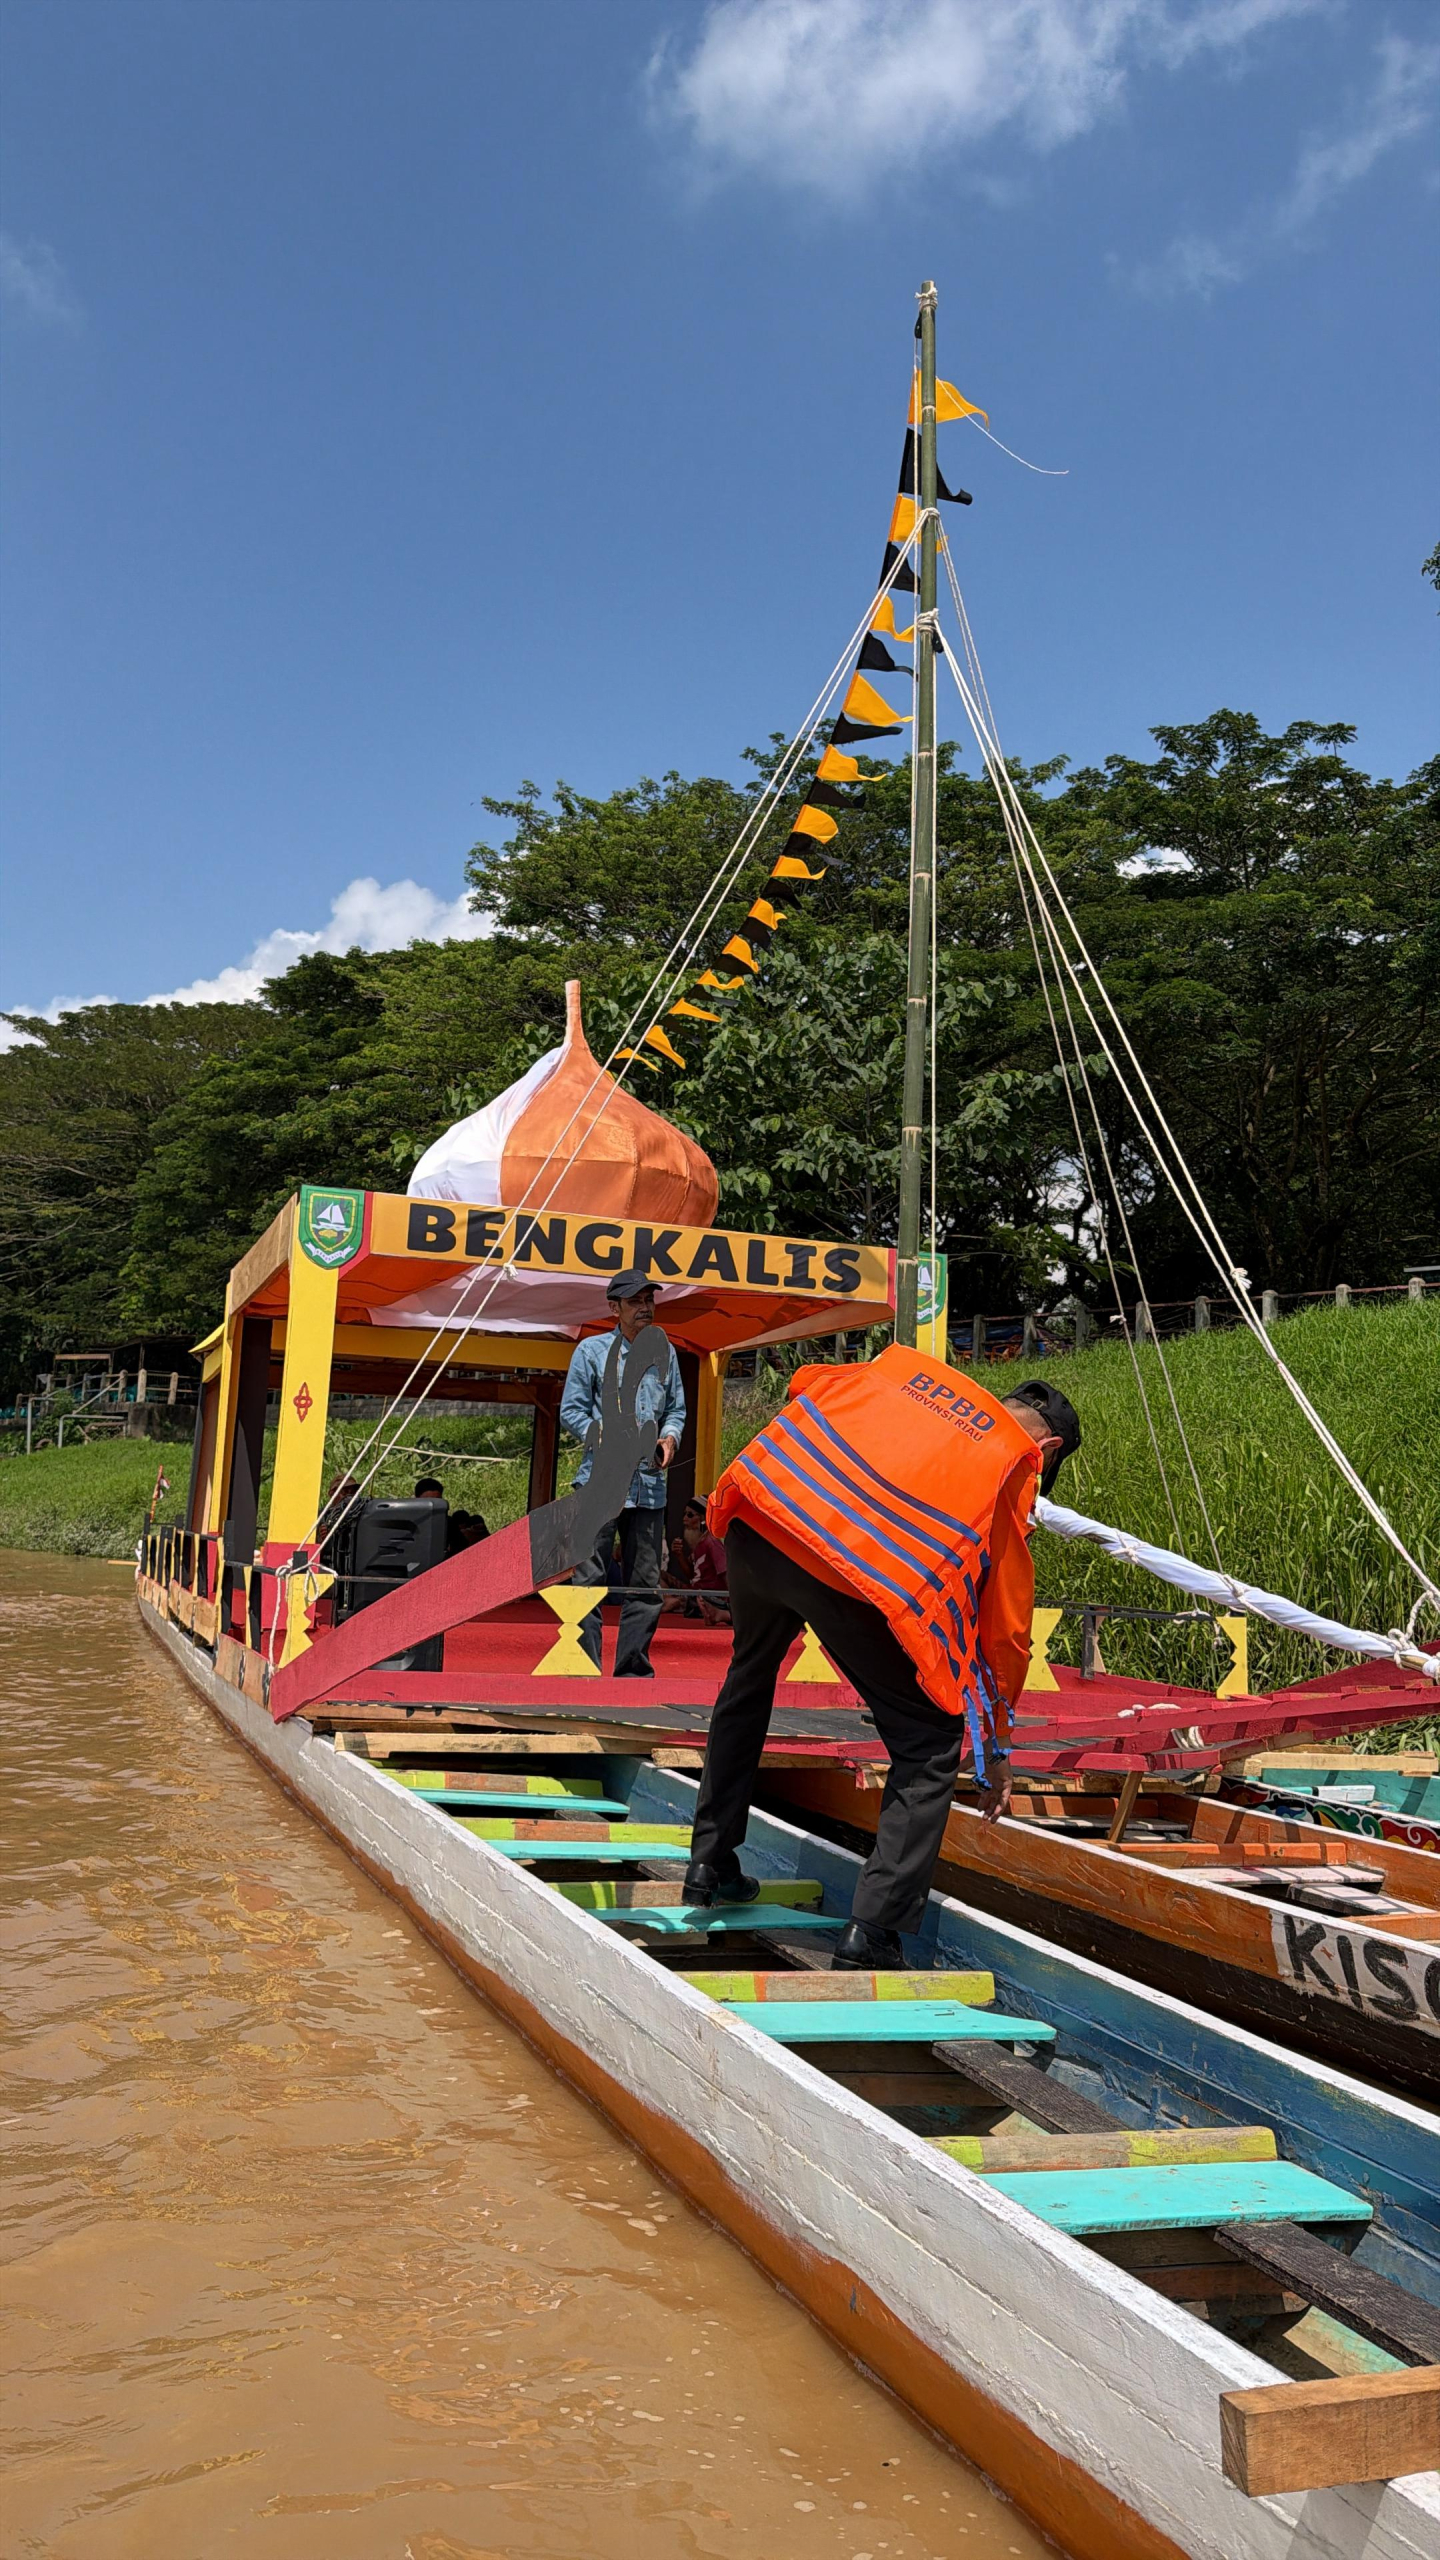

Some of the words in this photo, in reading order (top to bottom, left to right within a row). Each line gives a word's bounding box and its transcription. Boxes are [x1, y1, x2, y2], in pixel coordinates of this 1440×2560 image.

[406, 1202, 862, 1293] BENGKALIS
[900, 1385, 953, 1424] PROVINSI
[954, 1418, 984, 1443] RIAU
[907, 1372, 996, 1432] BPBD
